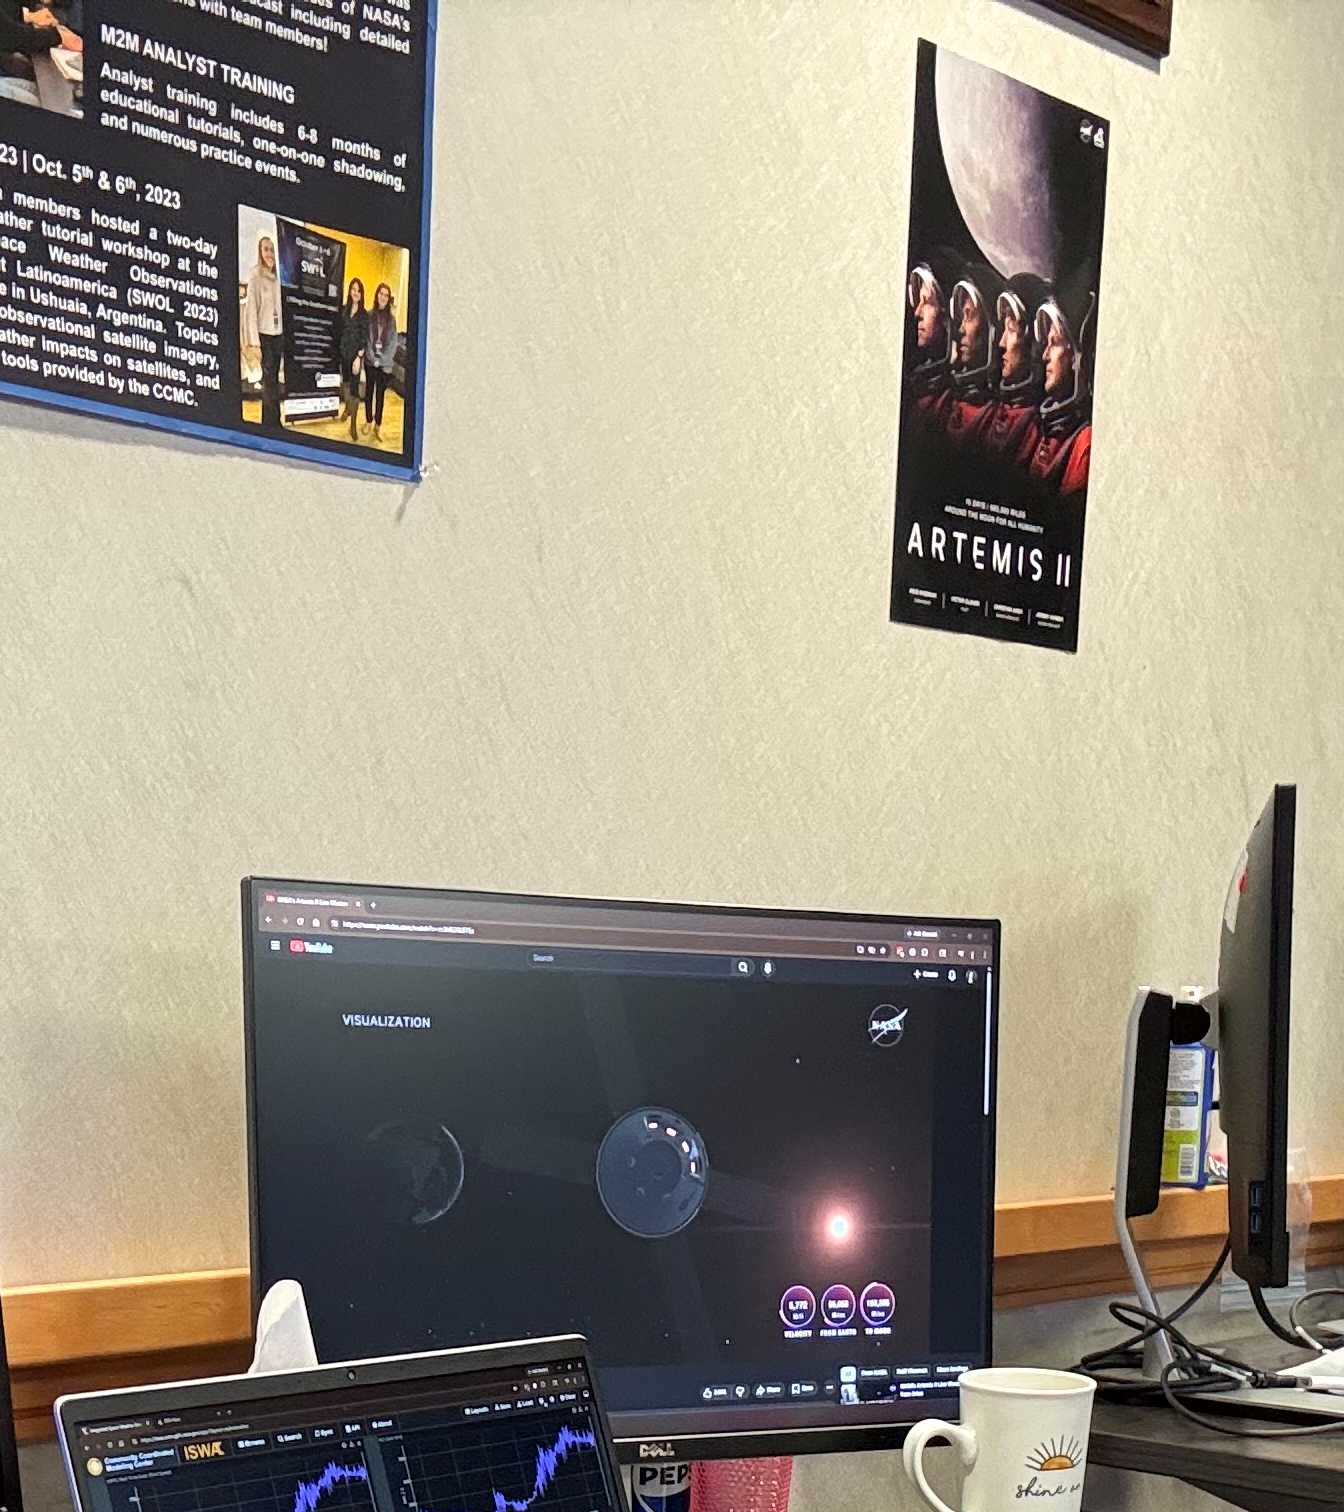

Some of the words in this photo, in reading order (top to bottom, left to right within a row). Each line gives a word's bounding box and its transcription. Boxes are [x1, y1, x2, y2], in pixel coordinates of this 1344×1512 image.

[100, 23, 139, 53] M2M
[142, 37, 217, 78] ANALYST
[219, 63, 295, 104] TRAINING
[99, 61, 154, 93] Analyst
[165, 83, 217, 117] training
[230, 102, 284, 134] includes
[297, 124, 318, 144] 6-8
[331, 137, 380, 161] months
[392, 152, 407, 168] of
[99, 88, 179, 124] educational
[186, 113, 244, 147] tutorials,
[252, 136, 325, 168] one-on-one
[332, 157, 405, 192] shadowing,
[100, 112, 128, 130] and
[131, 120, 197, 152] numerous
[200, 142, 252, 169] practice
[254, 159, 300, 183] events.
[31, 152, 67, 179] Oct.
[97, 170, 110, 190] &
[144, 182, 181, 209] 2023
[12, 191, 81, 220] members
[90, 207, 140, 236] hosted
[148, 226, 157, 240] a
[166, 228, 218, 260] two-day
[40, 219, 93, 247] tutorial
[100, 237, 170, 269] workshop
[176, 256, 190, 272] at
[197, 259, 218, 279] the
[907, 521, 1044, 582] ARTEMIS
[1056, 552, 1071, 588] II
[341, 1012, 432, 1030] VISUALIZATION
[639, 1442, 676, 1458] DELL
[1015, 1475, 1065, 1499] shine
